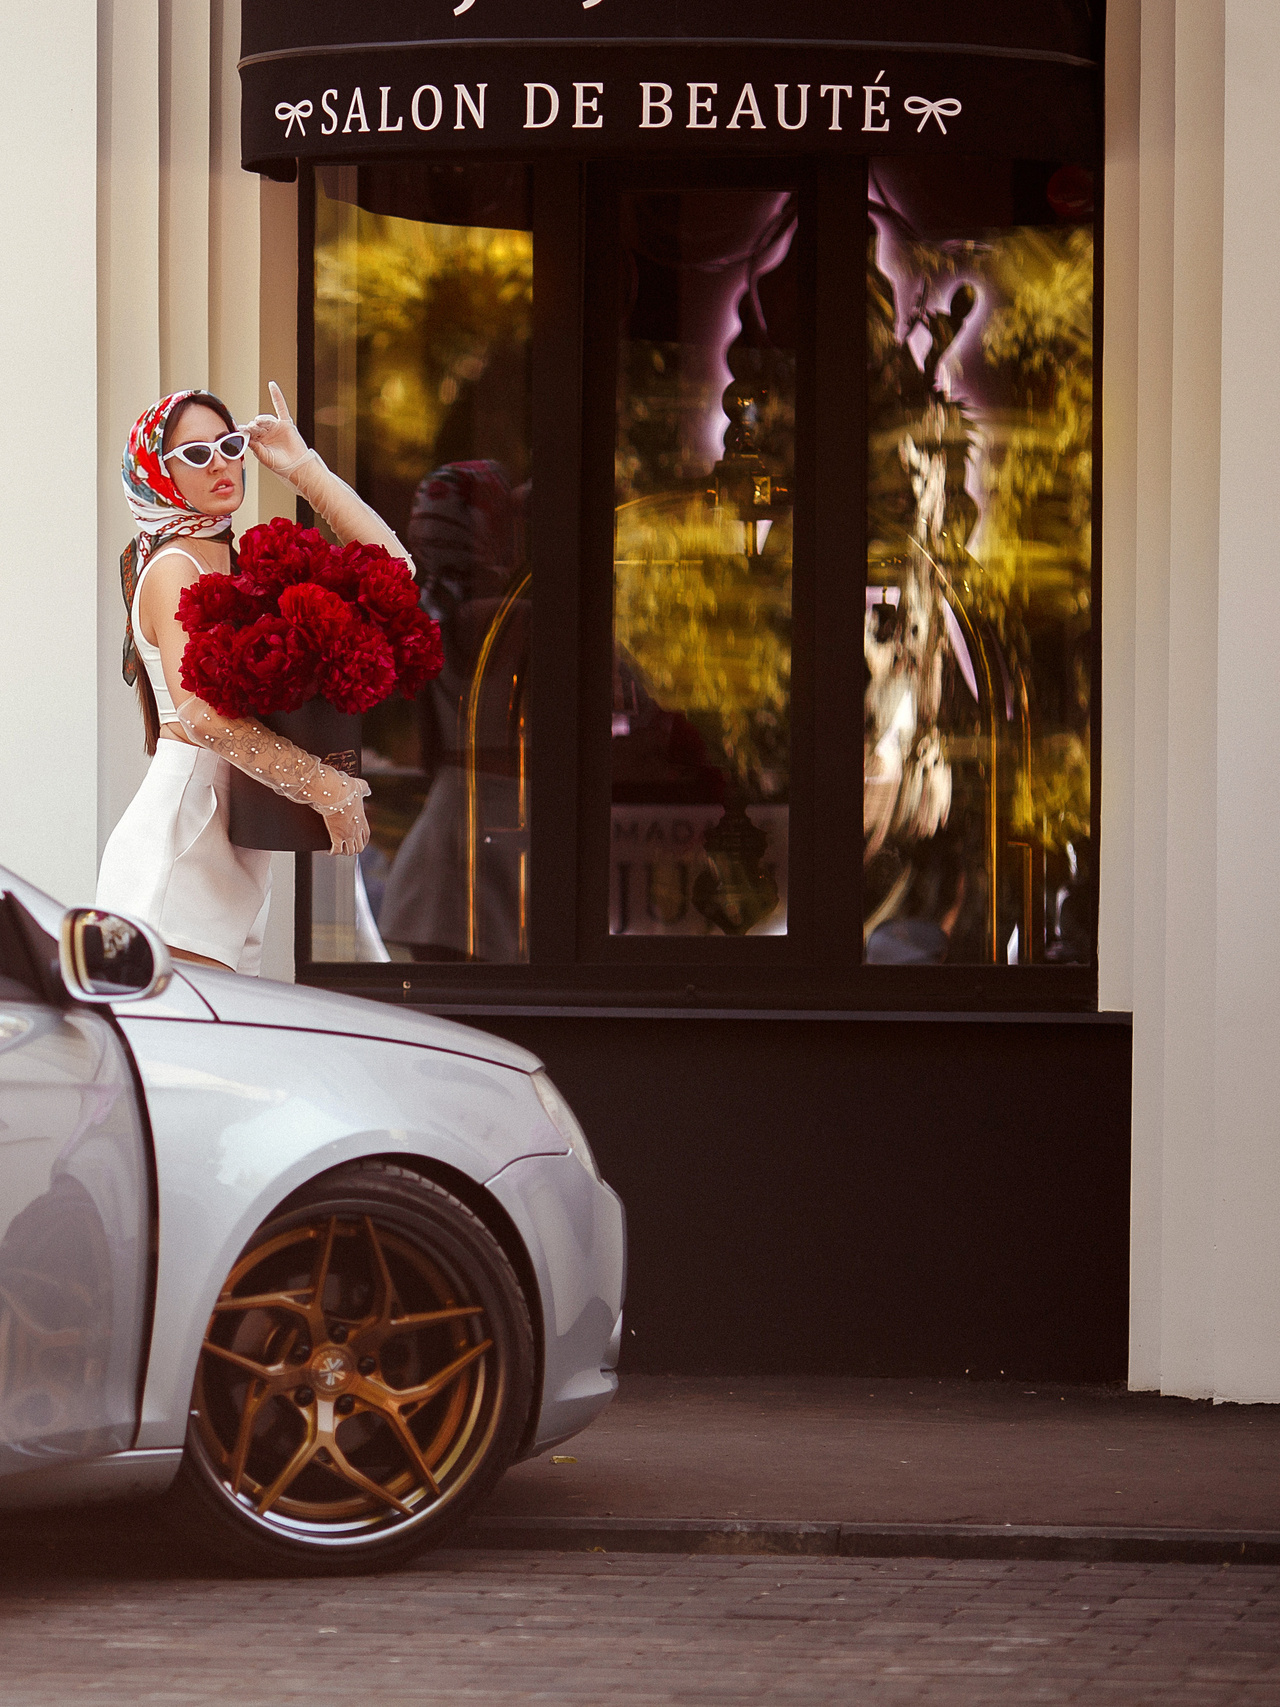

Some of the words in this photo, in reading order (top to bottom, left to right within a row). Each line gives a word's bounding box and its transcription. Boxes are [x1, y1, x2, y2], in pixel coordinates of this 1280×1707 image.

[321, 84, 489, 135] SALON
[522, 82, 604, 129] DE
[638, 70, 890, 132] BEAUTÉ
